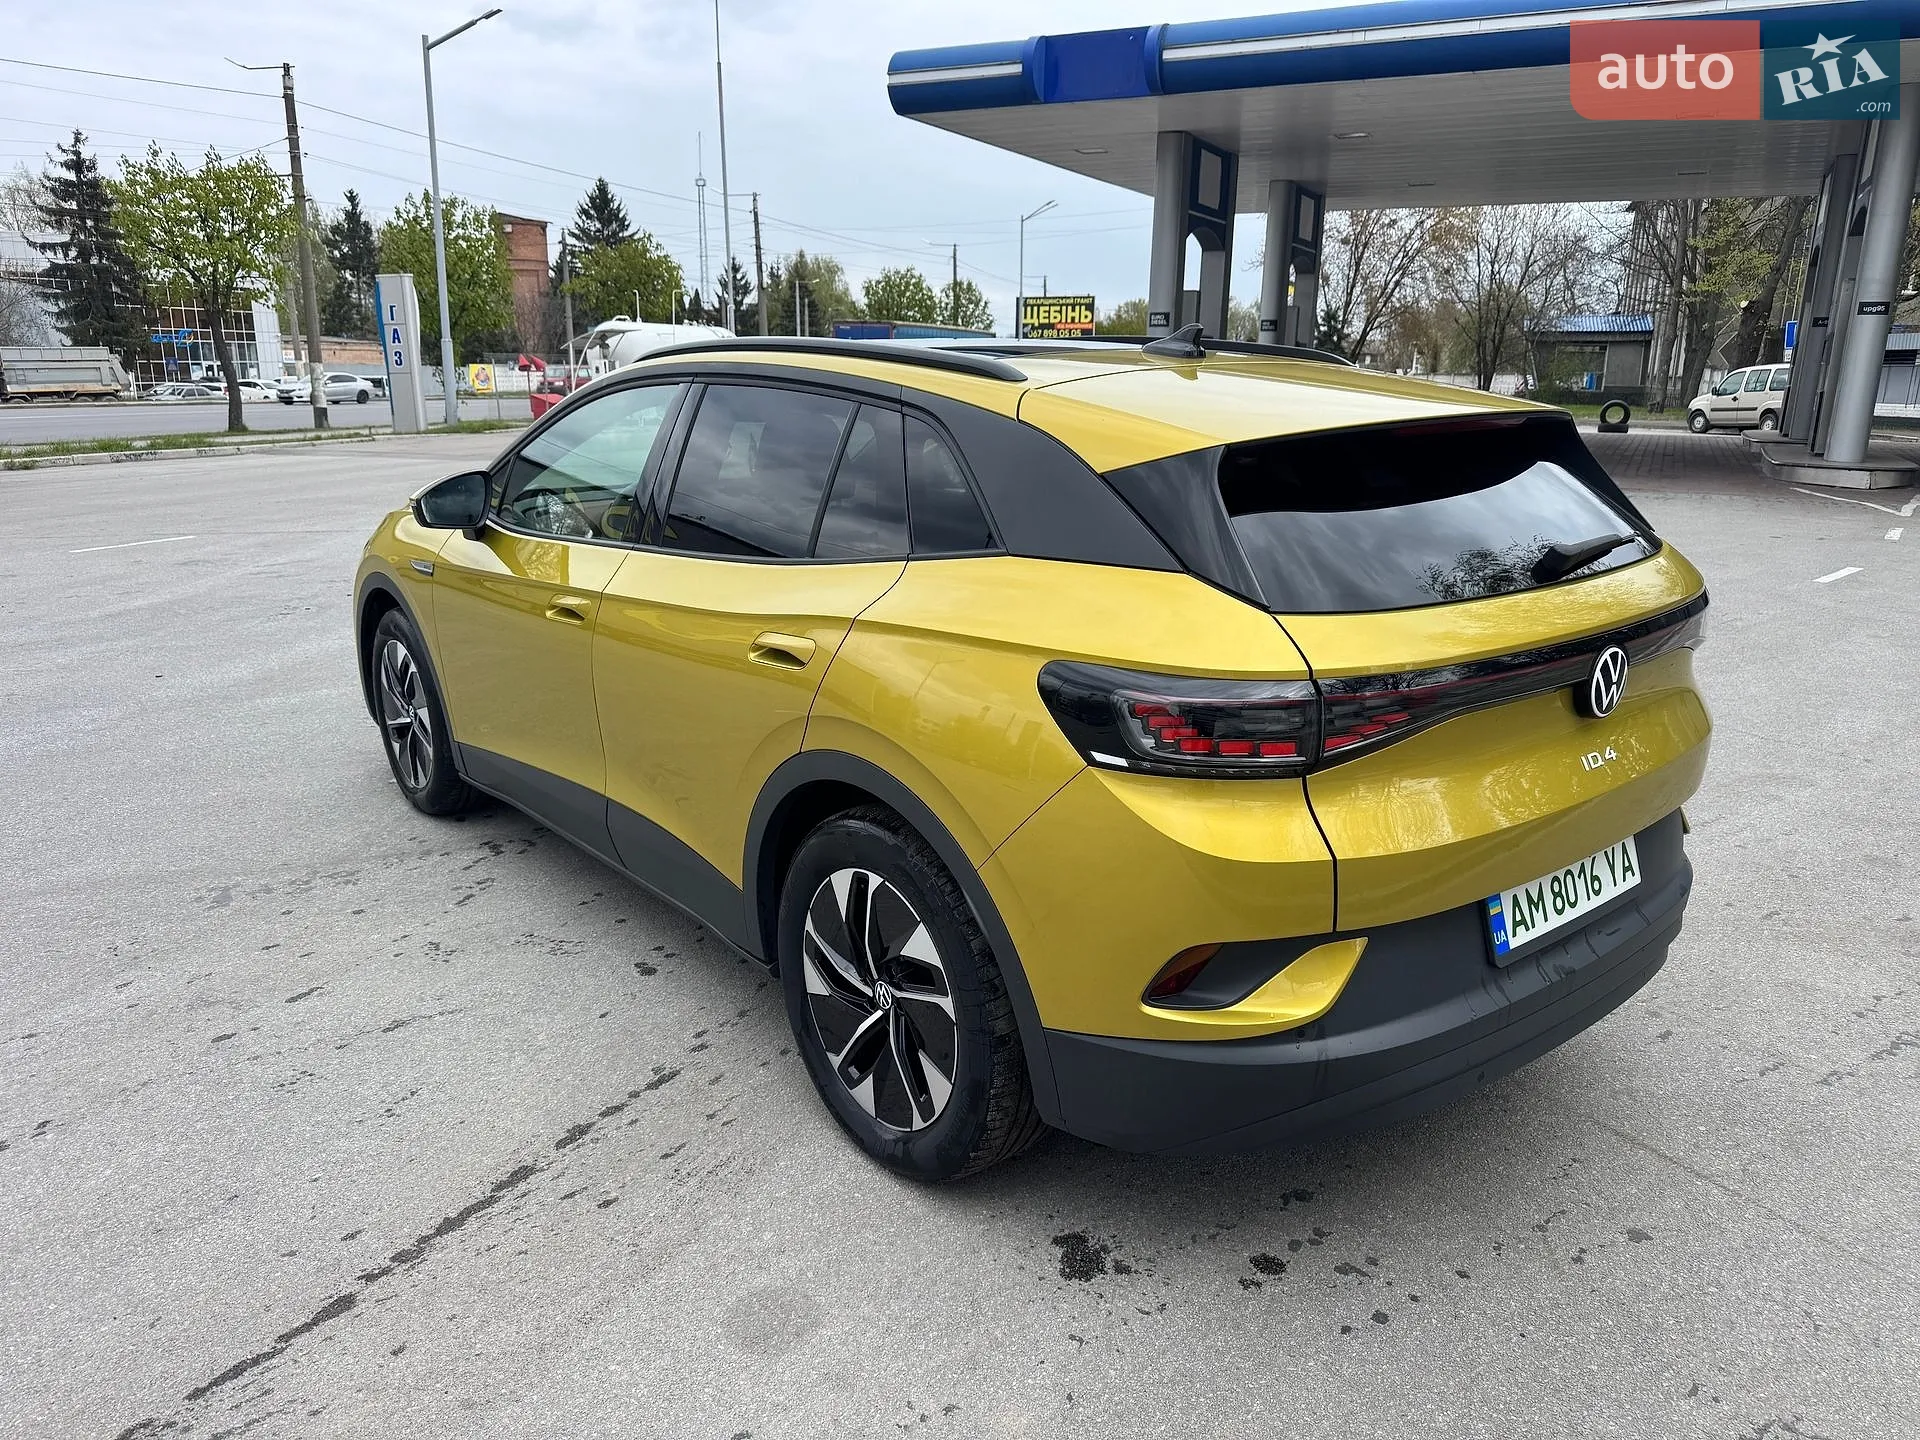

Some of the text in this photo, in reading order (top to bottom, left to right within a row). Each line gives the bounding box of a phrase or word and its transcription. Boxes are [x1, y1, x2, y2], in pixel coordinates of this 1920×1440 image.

[1022, 305, 1093, 326] ЩЕБІНЬ
[1863, 305, 1886, 313] upg95
[388, 304, 404, 367] ГАЗ
[1027, 329, 1082, 338] 067 898 05 05
[1512, 841, 1636, 938] AM 8016 YA
[1494, 931, 1508, 945] UA
